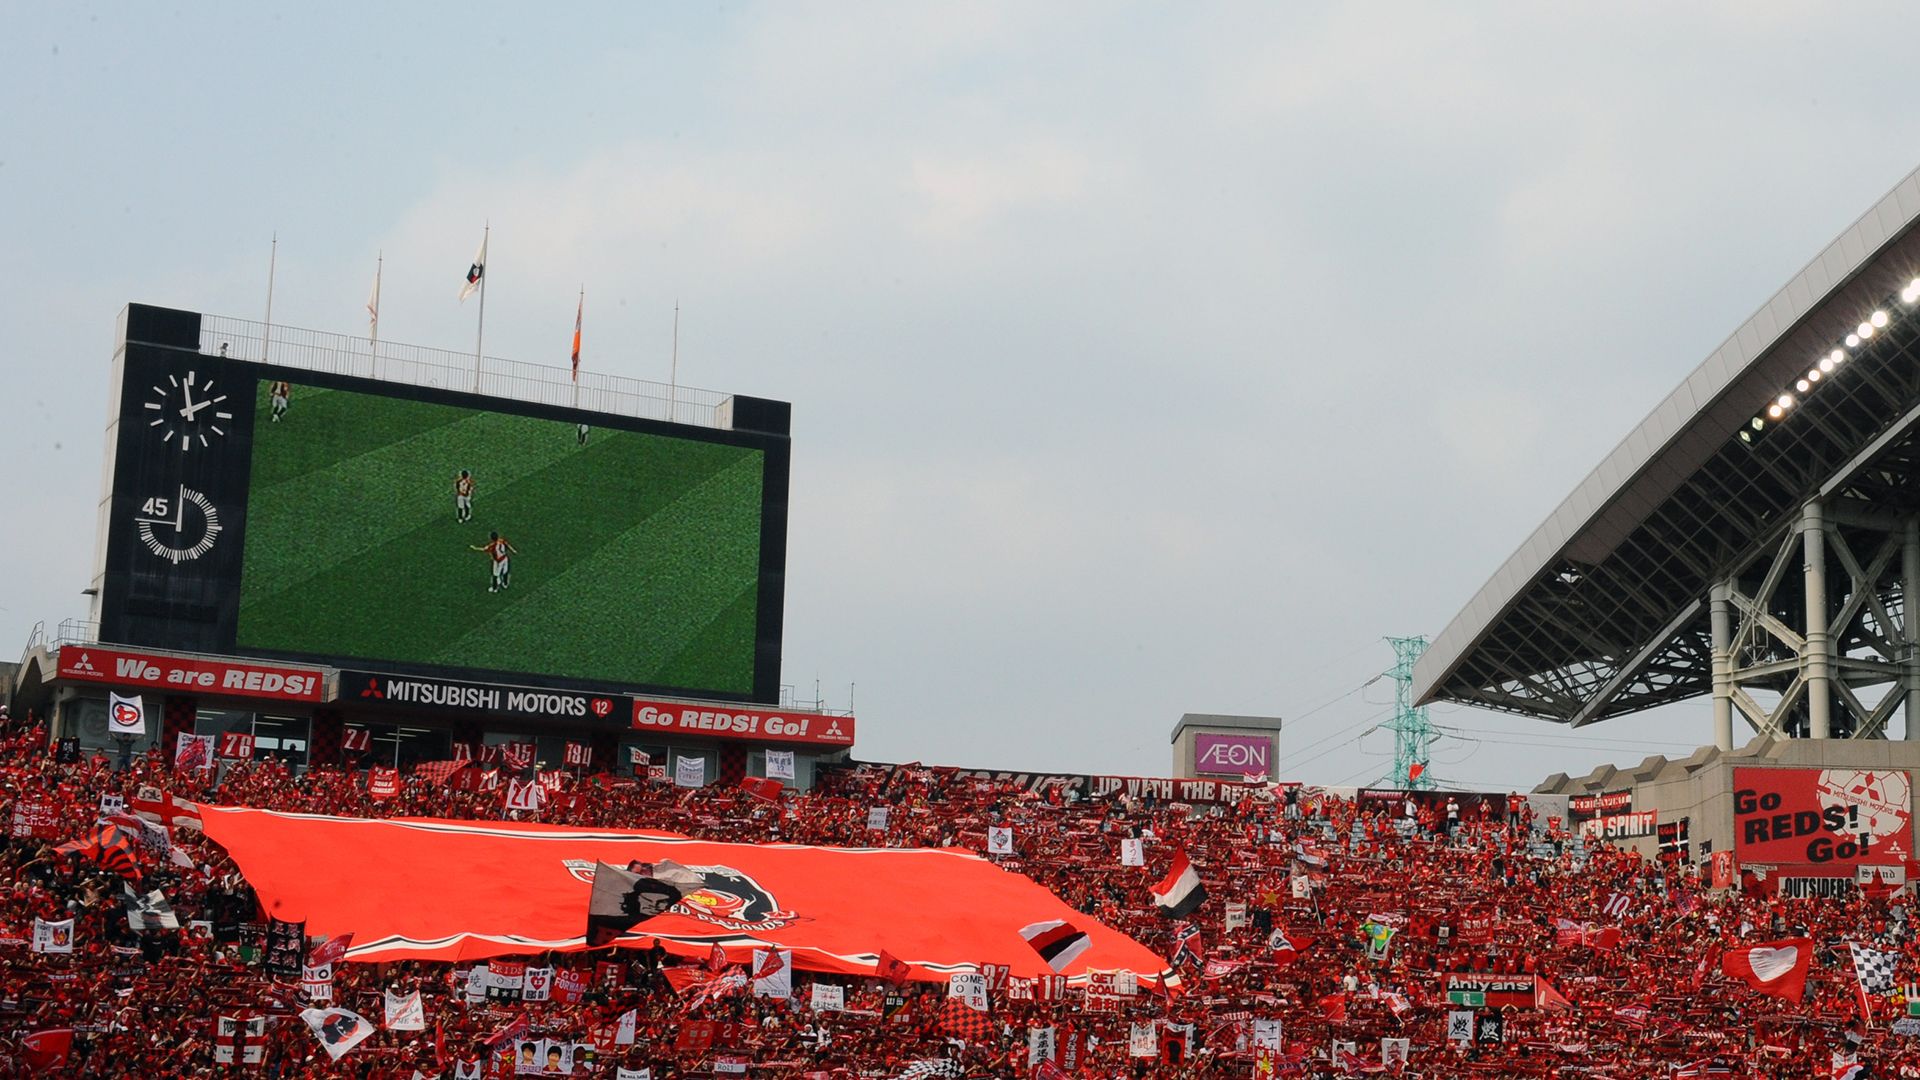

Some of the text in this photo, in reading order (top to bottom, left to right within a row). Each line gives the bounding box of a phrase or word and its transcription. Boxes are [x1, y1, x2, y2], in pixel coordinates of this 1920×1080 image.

[142, 497, 168, 516] 45
[116, 658, 315, 695] We are REDS!
[386, 680, 587, 716] MITSUBISHI MOTORS
[595, 701, 608, 714] 12
[637, 706, 810, 736] Go REDS! Go!
[224, 734, 252, 757] 26
[1099, 777, 1122, 796] UP
[1180, 781, 1216, 800] THE
[1734, 789, 1781, 815] Go
[1833, 790, 1894, 815] MITSUBISHI MOTORS
[1608, 814, 1653, 837] SPIRIT
[1745, 804, 1859, 845] REDS!
[1806, 832, 1870, 863] Go!
[1297, 881, 1305, 892] 3
[1785, 877, 1853, 898] OUTSIDERS
[1603, 893, 1631, 915] 10
[304, 969, 329, 980] NO
[561, 970, 579, 981] GO
[952, 974, 984, 985] COME
[1091, 974, 1116, 984] GET
[956, 984, 982, 994] ON
[1087, 984, 1118, 995] GOAL
[723, 1023, 732, 1038] 2
